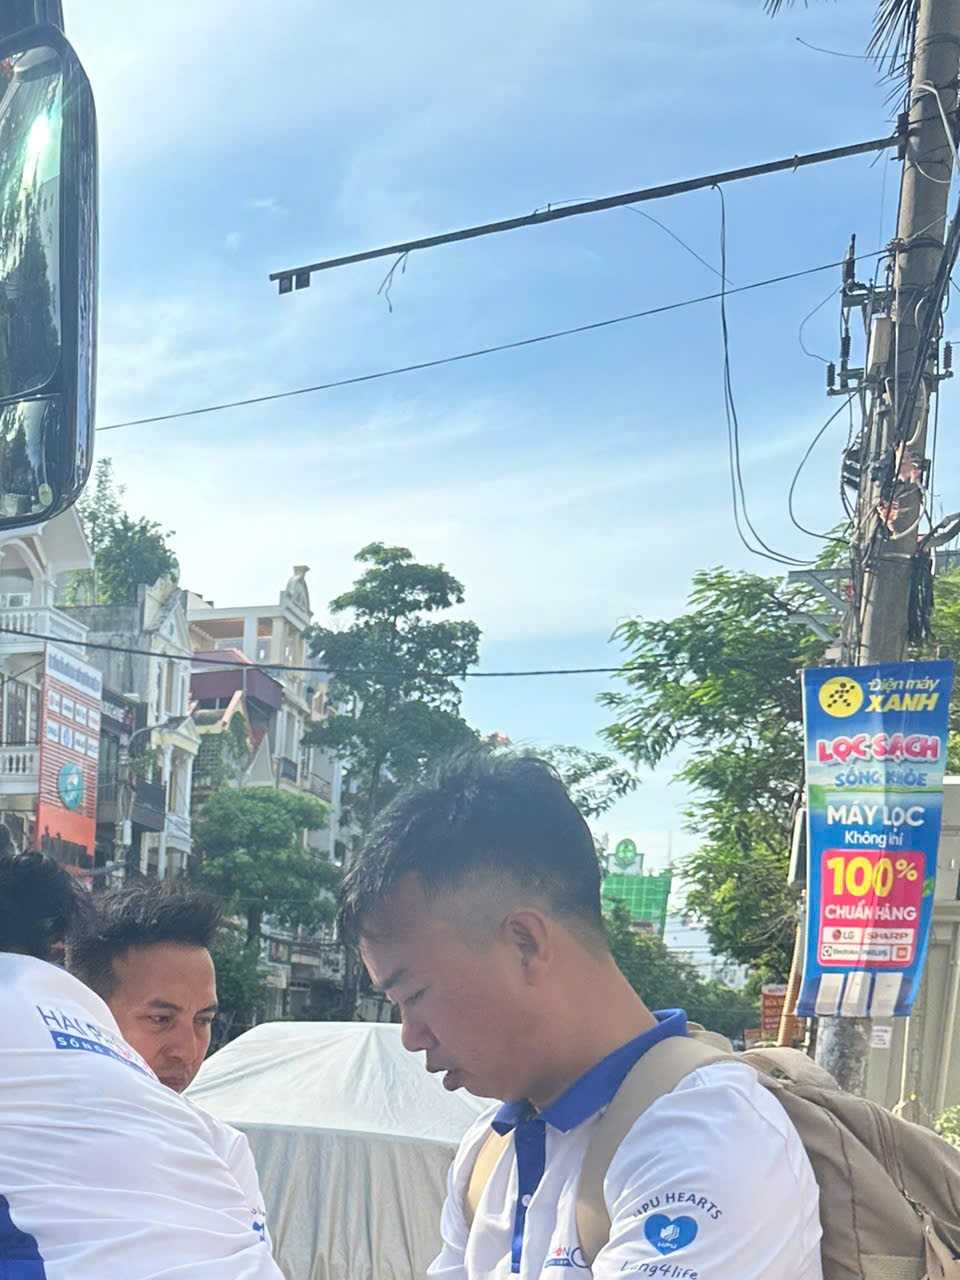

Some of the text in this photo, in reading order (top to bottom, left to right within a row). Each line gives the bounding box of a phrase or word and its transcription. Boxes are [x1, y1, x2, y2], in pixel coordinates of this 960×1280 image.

[906, 676, 940, 691] máy
[865, 693, 939, 712] XANH
[817, 733, 940, 763] LỌC SẠCH
[827, 801, 925, 832] MÁY LỌC
[845, 831, 887, 848] Không
[826, 857, 918, 897] 100%
[843, 930, 909, 940] LG SHARP
[665, 1192, 723, 1220] HEARTS
